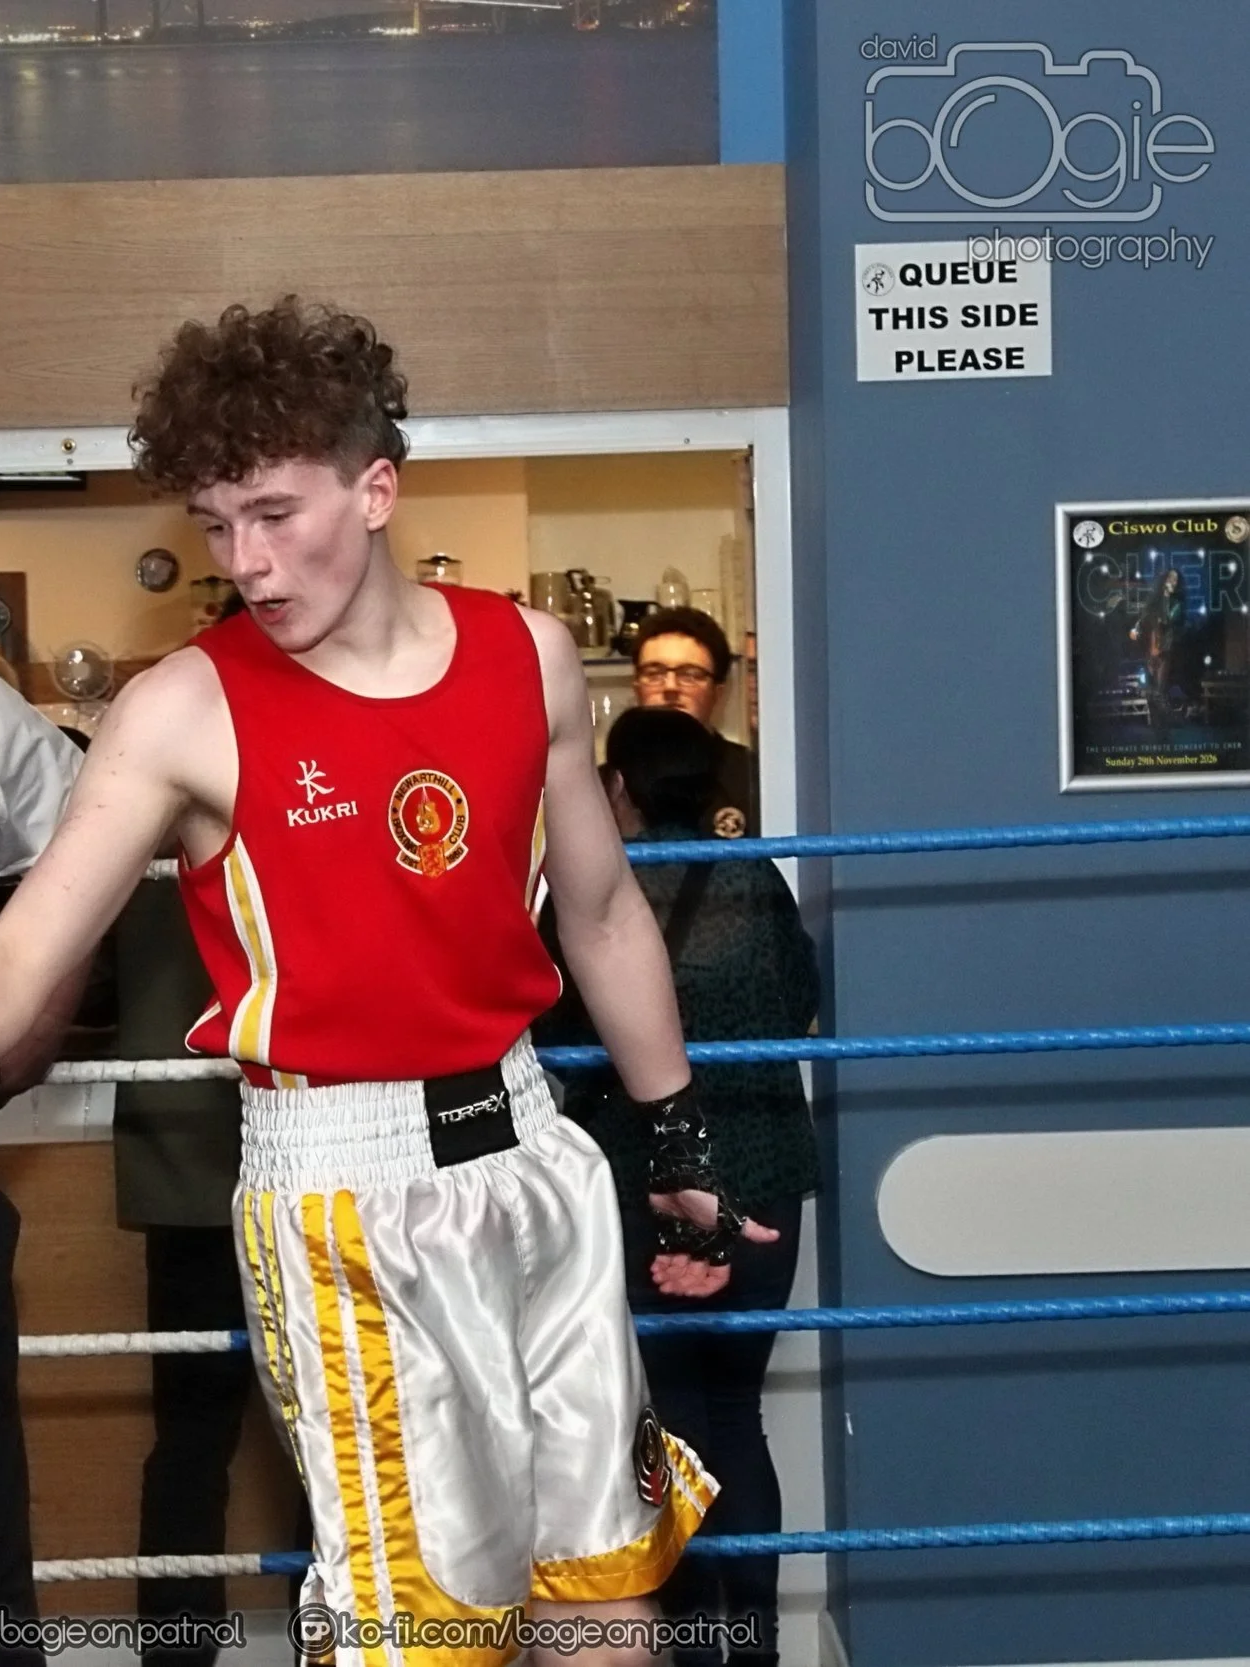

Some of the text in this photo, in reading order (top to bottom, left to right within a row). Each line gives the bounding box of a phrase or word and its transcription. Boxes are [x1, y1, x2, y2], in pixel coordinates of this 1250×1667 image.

[899, 260, 1018, 288] QUEUE
[868, 303, 1039, 330] THIS SIDE
[895, 347, 1025, 373] PLEASE
[1108, 521, 1167, 535] Ciswo
[1172, 519, 1218, 532] Club
[1077, 551, 1248, 617] CHER
[1105, 756, 1136, 768] Sunday
[1155, 754, 1198, 765] November
[396, 773, 455, 801] NEWARTHILL
[287, 801, 358, 827] KUKRI
[392, 815, 466, 855] BOXING CLUB
[438, 1091, 505, 1124] TORPEX
